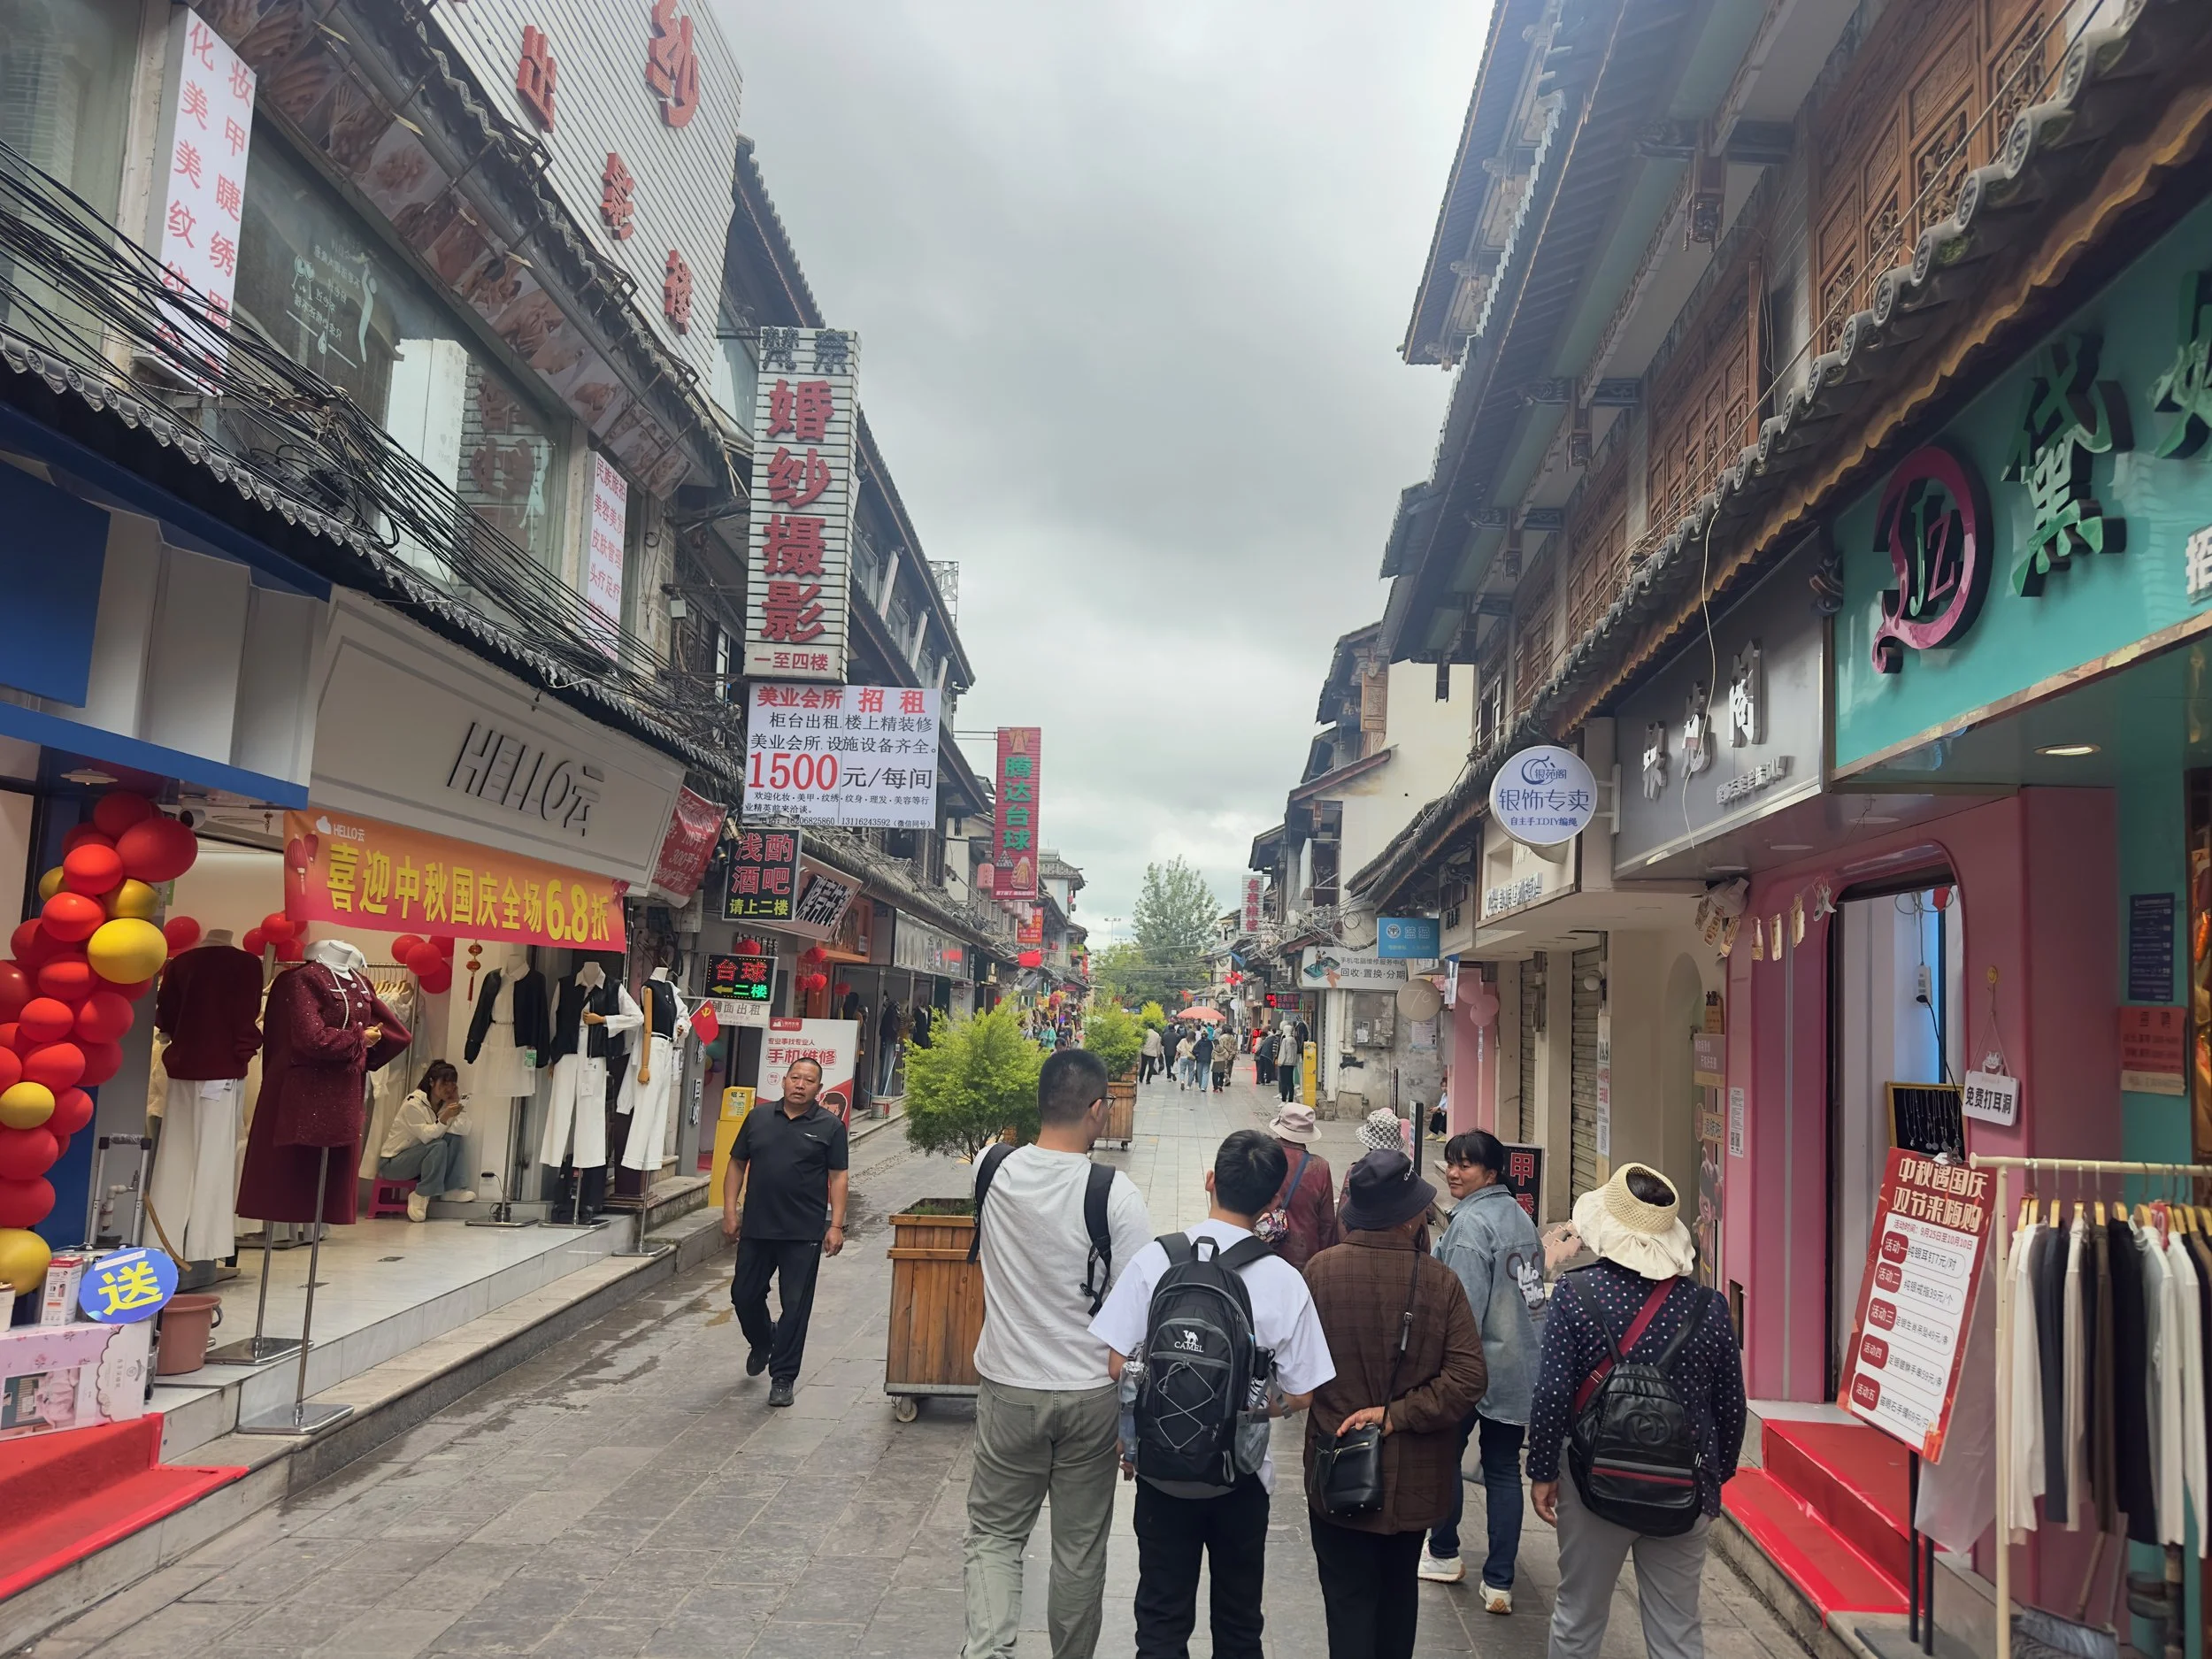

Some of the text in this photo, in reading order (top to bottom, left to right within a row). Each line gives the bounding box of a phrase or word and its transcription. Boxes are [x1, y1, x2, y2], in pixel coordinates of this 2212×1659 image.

[188, 21, 254, 110] 化妆
[180, 79, 246, 157] 美甲
[174, 139, 242, 222] 美睫
[167, 199, 235, 279] 纹绣
[594, 493, 625, 539] 美容美发
[760, 378, 834, 642] 婚纱摄影
[591, 527, 623, 571] 皮肤管理
[589, 563, 620, 603] 头疗足疗
[753, 651, 829, 672] 一至四楼
[757, 686, 843, 710] 美业会所
[1002, 755, 1033, 851] 腾达台球
[1498, 788, 1590, 811] 银饰专卖
[1510, 817, 1578, 827] 自主手工DIY编绳
[733, 832, 795, 863] 浅酌
[730, 865, 791, 895] 酒吧
[326, 841, 611, 944] 喜迎中秋国庆全场6.8折
[728, 898, 789, 917] 请上二楼
[715, 958, 768, 982] 台球
[1340, 956, 1407, 967] 手机电脑维修服务中心
[1340, 968, 1407, 980] 回收·置换·分期
[733, 984, 768, 999] 二楼
[767, 1037, 815, 1046] 专业事找专业人
[767, 1048, 837, 1065] 手机维修
[1965, 1086, 2013, 1116] 免费打耳洞
[1898, 1157, 1990, 1201] 中秋遇国庆
[1893, 1187, 1983, 1233] 双节来嗨购
[1884, 1238, 1908, 1255] 活动一
[1878, 1266, 1901, 1285] 活动二
[97, 1261, 164, 1316] 送
[1870, 1304, 1894, 1325] 活动三
[1173, 1340, 1204, 1353] CAMEL
[1863, 1341, 1883, 1360] 活动四
[1855, 1382, 1876, 1402] 活动五
